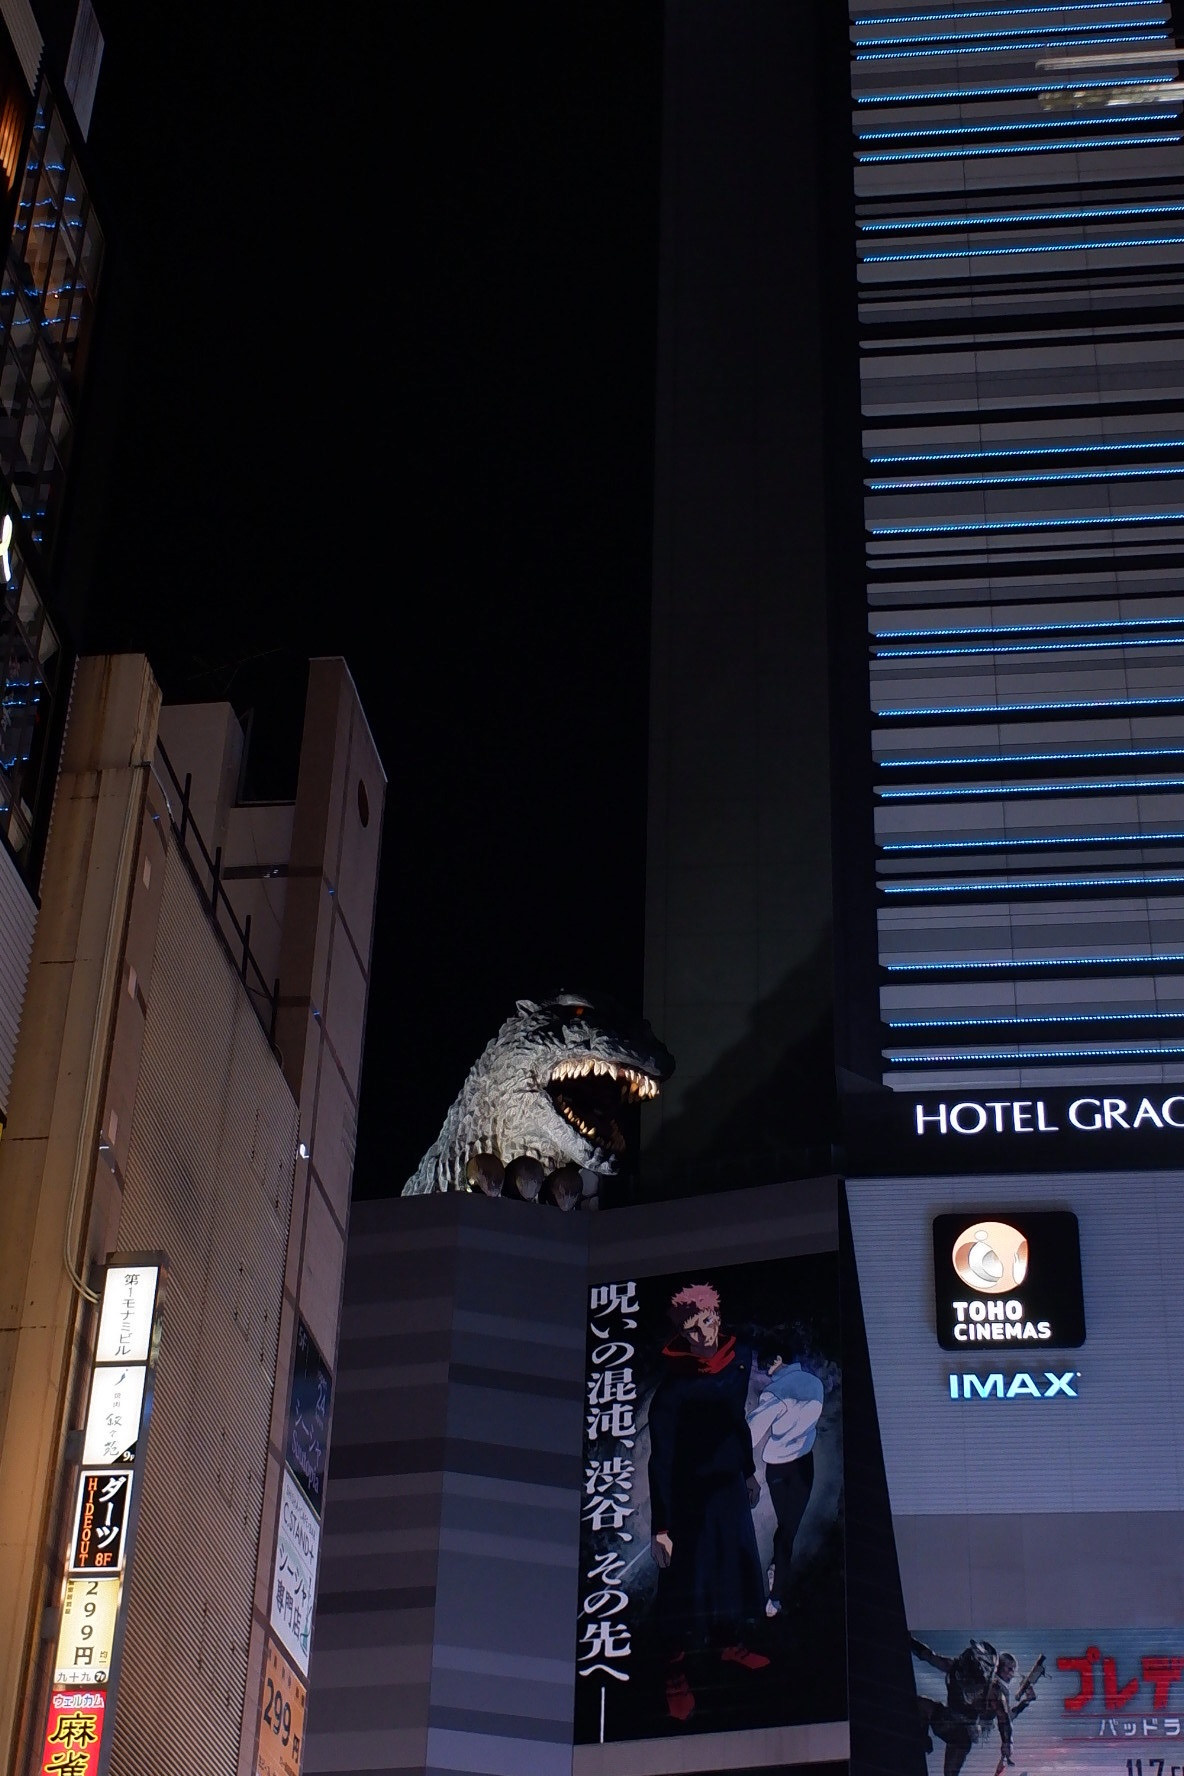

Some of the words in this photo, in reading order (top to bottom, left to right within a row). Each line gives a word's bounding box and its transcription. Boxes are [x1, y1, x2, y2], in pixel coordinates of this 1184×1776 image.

[915, 1101, 1059, 1134] HOTEL
[952, 1300, 1023, 1321] TOHO
[953, 1322, 1052, 1341] CINEMAS
[949, 1372, 1078, 1399] IMAX
[79, 1477, 98, 1567] HIDEOUT
[96, 1476, 127, 1549] ダーツ
[95, 1552, 112, 1567] 8F
[279, 1543, 307, 1606] シーシャ
[276, 1579, 301, 1641] 専門店
[53, 1693, 104, 1708] ウェルカム
[46, 1711, 98, 1776] 麻雀
